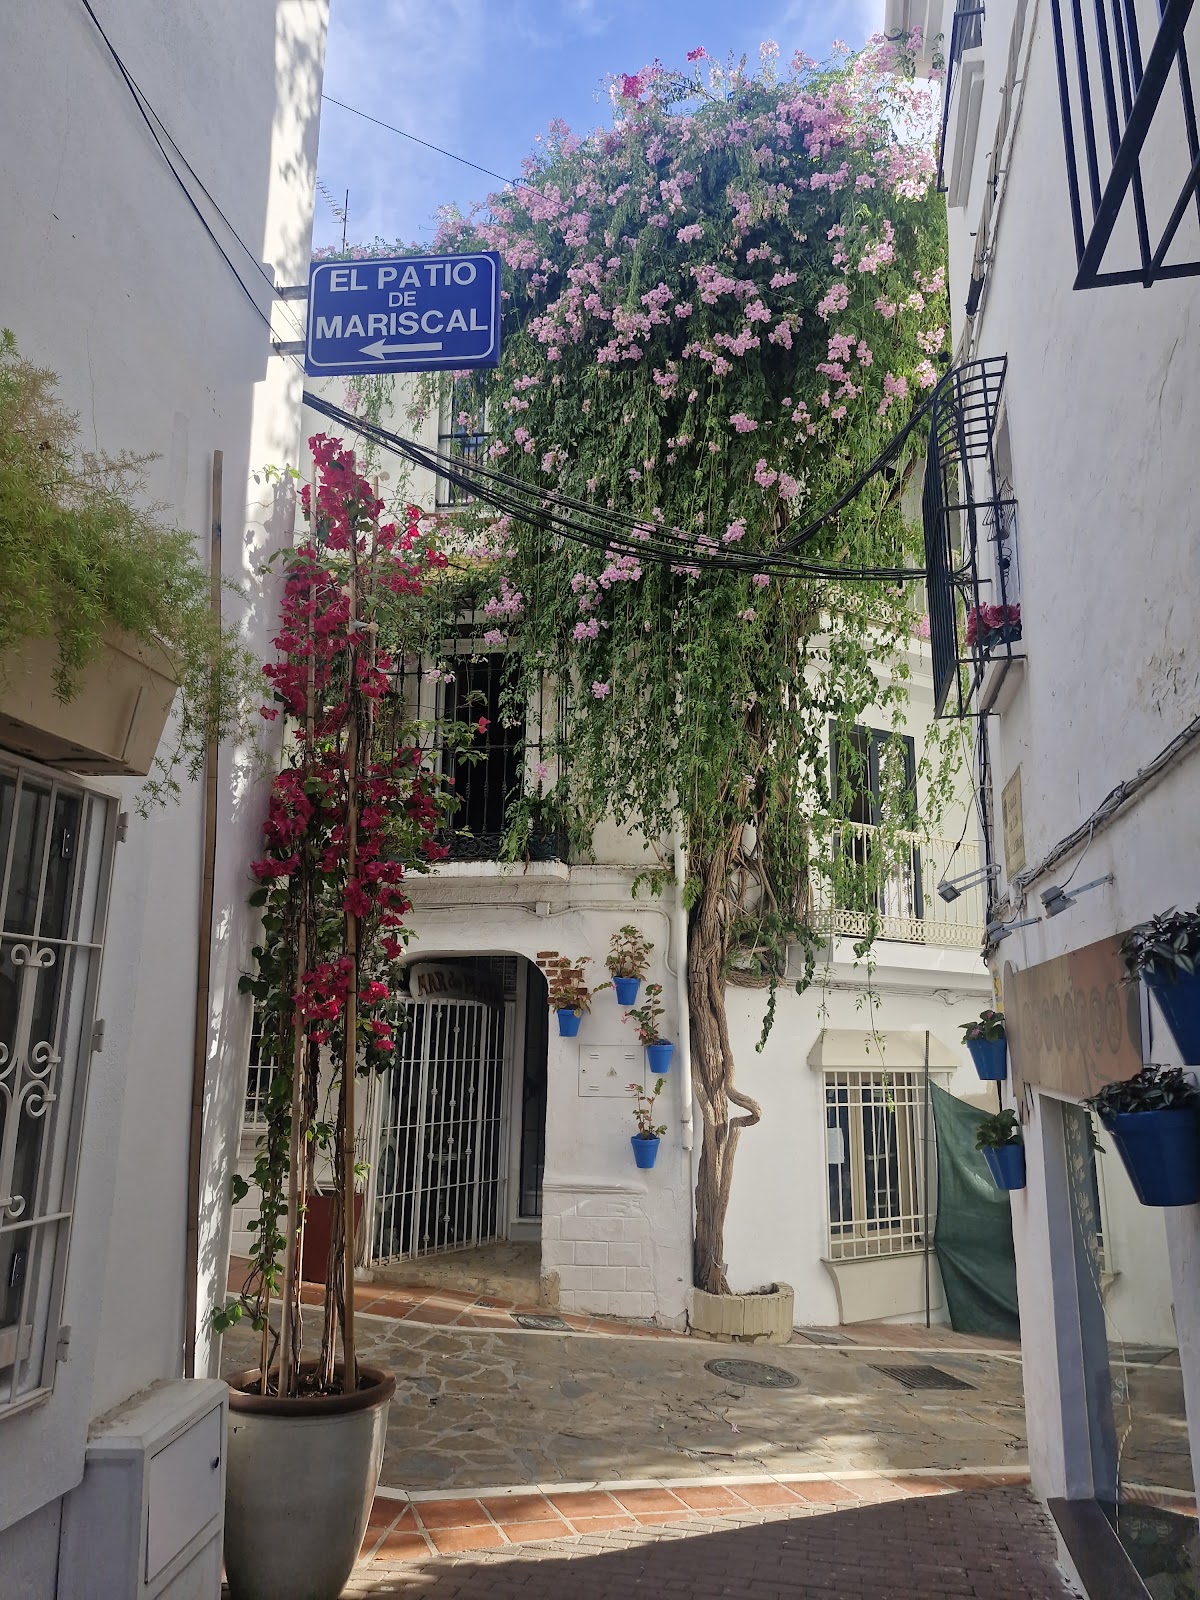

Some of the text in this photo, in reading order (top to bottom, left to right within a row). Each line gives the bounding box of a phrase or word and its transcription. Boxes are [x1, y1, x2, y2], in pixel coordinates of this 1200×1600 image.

[329, 262, 477, 292] EL PATIO
[388, 290, 417, 308] DE
[315, 308, 489, 340] MARISCAL
